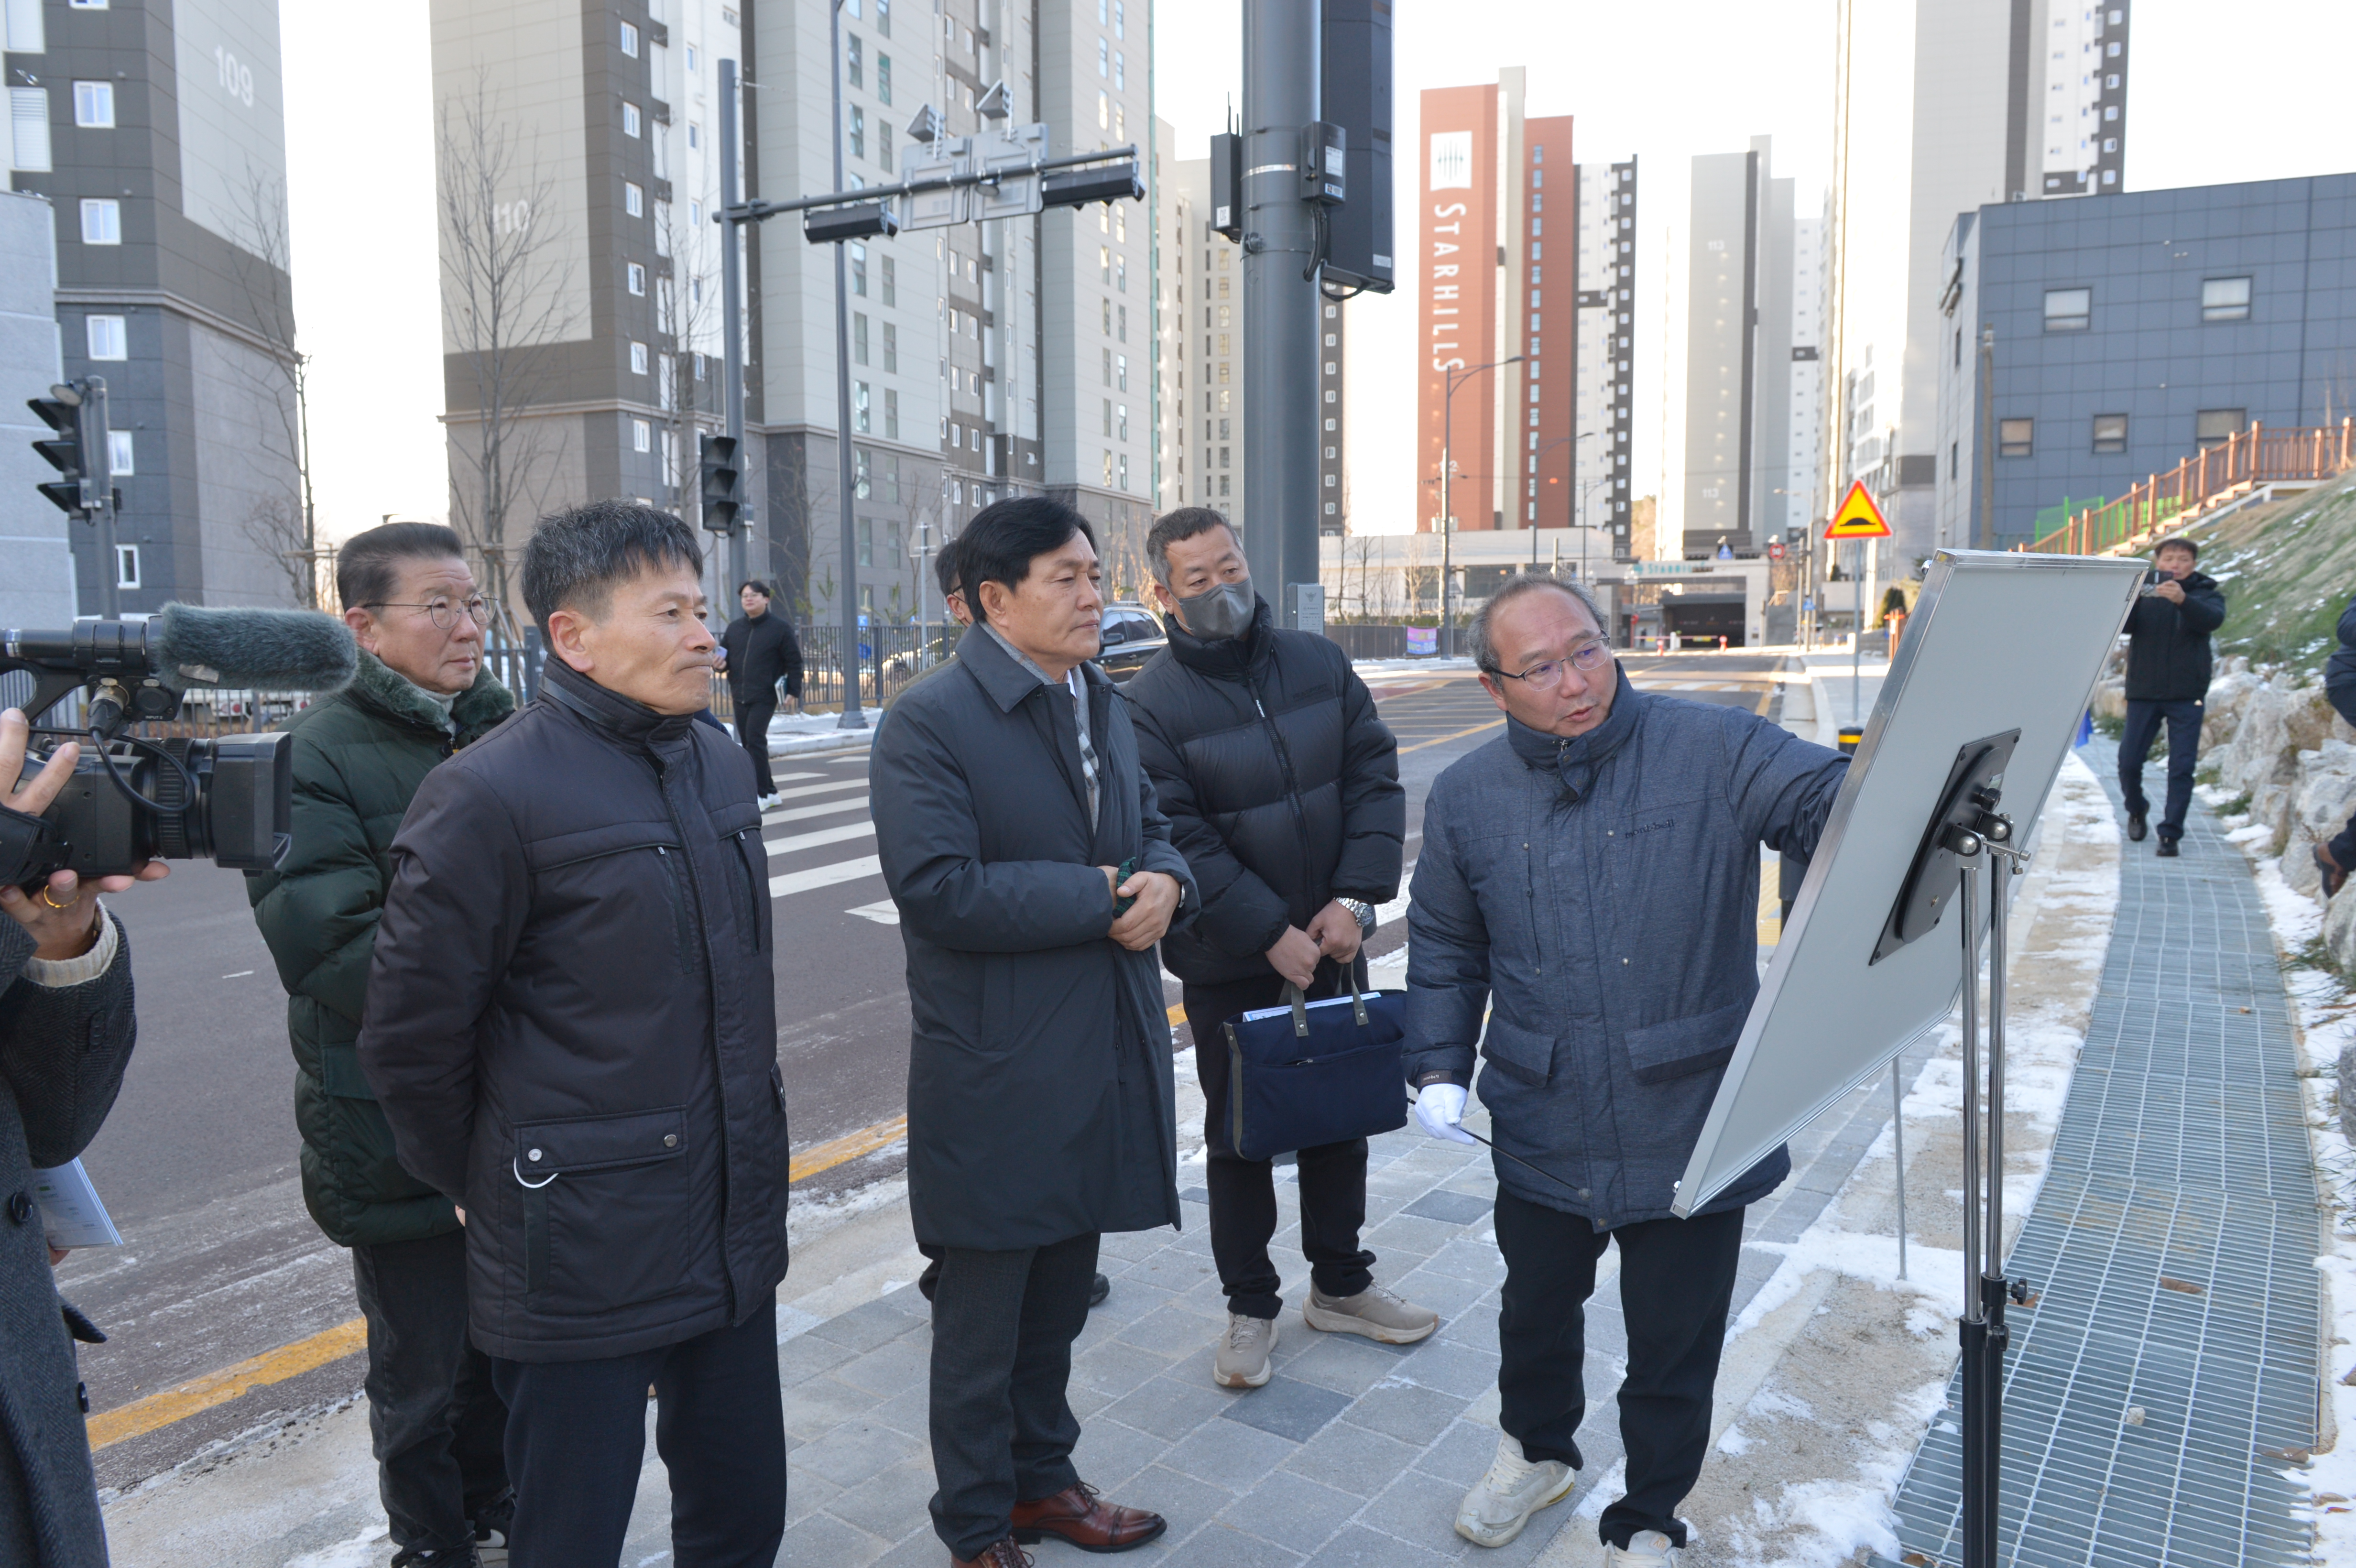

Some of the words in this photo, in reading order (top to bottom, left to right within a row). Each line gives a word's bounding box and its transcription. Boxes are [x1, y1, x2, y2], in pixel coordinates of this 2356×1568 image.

[214, 44, 254, 108] 109
[493, 199, 532, 234] 110
[1433, 202, 1467, 372] STARHILLS
[1702, 488, 1719, 499] 113
[1653, 1540, 1666, 1550] AIR
